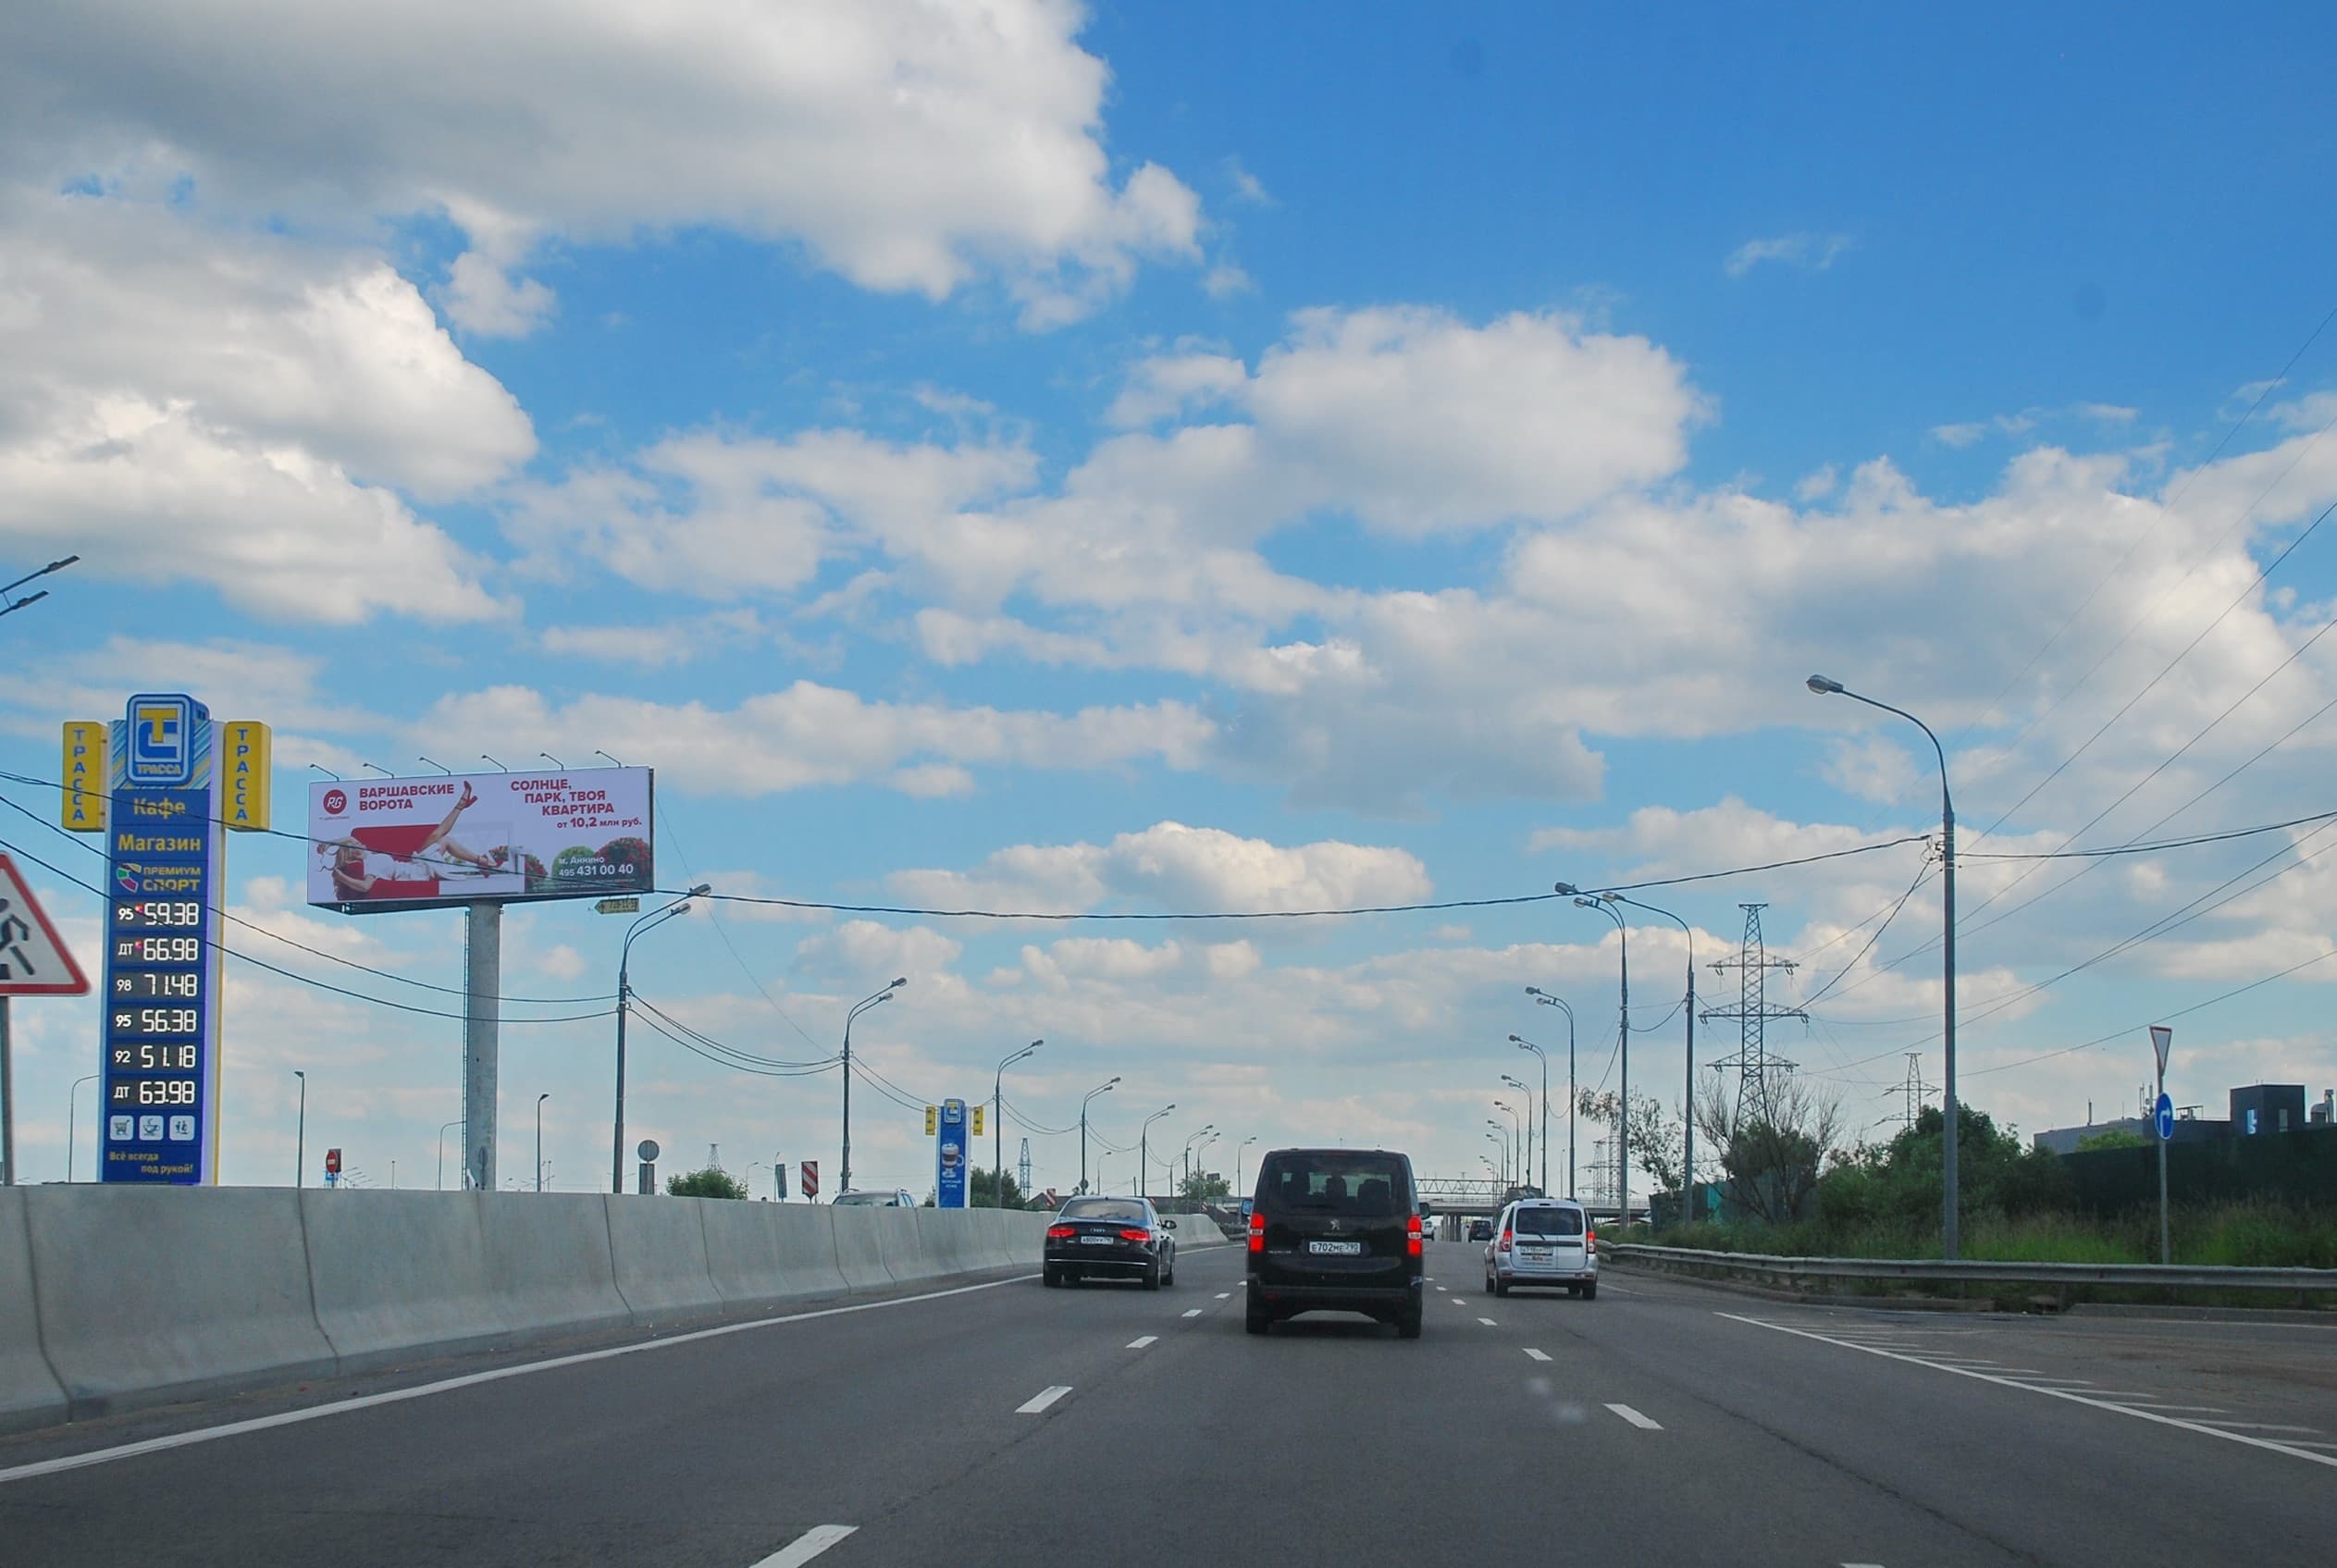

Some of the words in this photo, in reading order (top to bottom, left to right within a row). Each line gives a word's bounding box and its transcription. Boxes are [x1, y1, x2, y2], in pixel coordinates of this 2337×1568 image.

[71, 728, 86, 821] ТРАССА
[136, 763, 182, 775] ТРАССА
[234, 728, 249, 821] ТРАССА
[359, 784, 454, 798] ВАРШАВСКИЕ
[511, 778, 572, 791] СОЛНЦЕ,
[359, 798, 414, 810] ВОРОТА
[525, 792, 565, 804] ПАРК,
[569, 790, 606, 802] ТВОЯ
[133, 796, 186, 819] Кафе
[542, 803, 614, 816] КВАРТИРА
[570, 817, 597, 829] 10,2
[600, 819, 619, 827] млн
[117, 833, 201, 852] Магазин
[142, 866, 201, 876] ПРЕМИУМ
[559, 869, 575, 877] 495
[576, 865, 597, 876] 431
[618, 864, 634, 874] 40
[142, 879, 201, 892] СПОРТ
[118, 907, 134, 920] 95
[143, 902, 200, 926] 59.38
[117, 944, 134, 956] ДТ
[143, 938, 199, 961] 66.98
[117, 979, 132, 992] 98
[143, 973, 198, 996] 71.48
[116, 1015, 131, 1027] 95
[142, 1009, 197, 1032] 56.38
[115, 1050, 131, 1063] 92
[141, 1044, 196, 1068] 51.18
[113, 1086, 130, 1099] ДТ
[140, 1080, 195, 1105] 63.98
